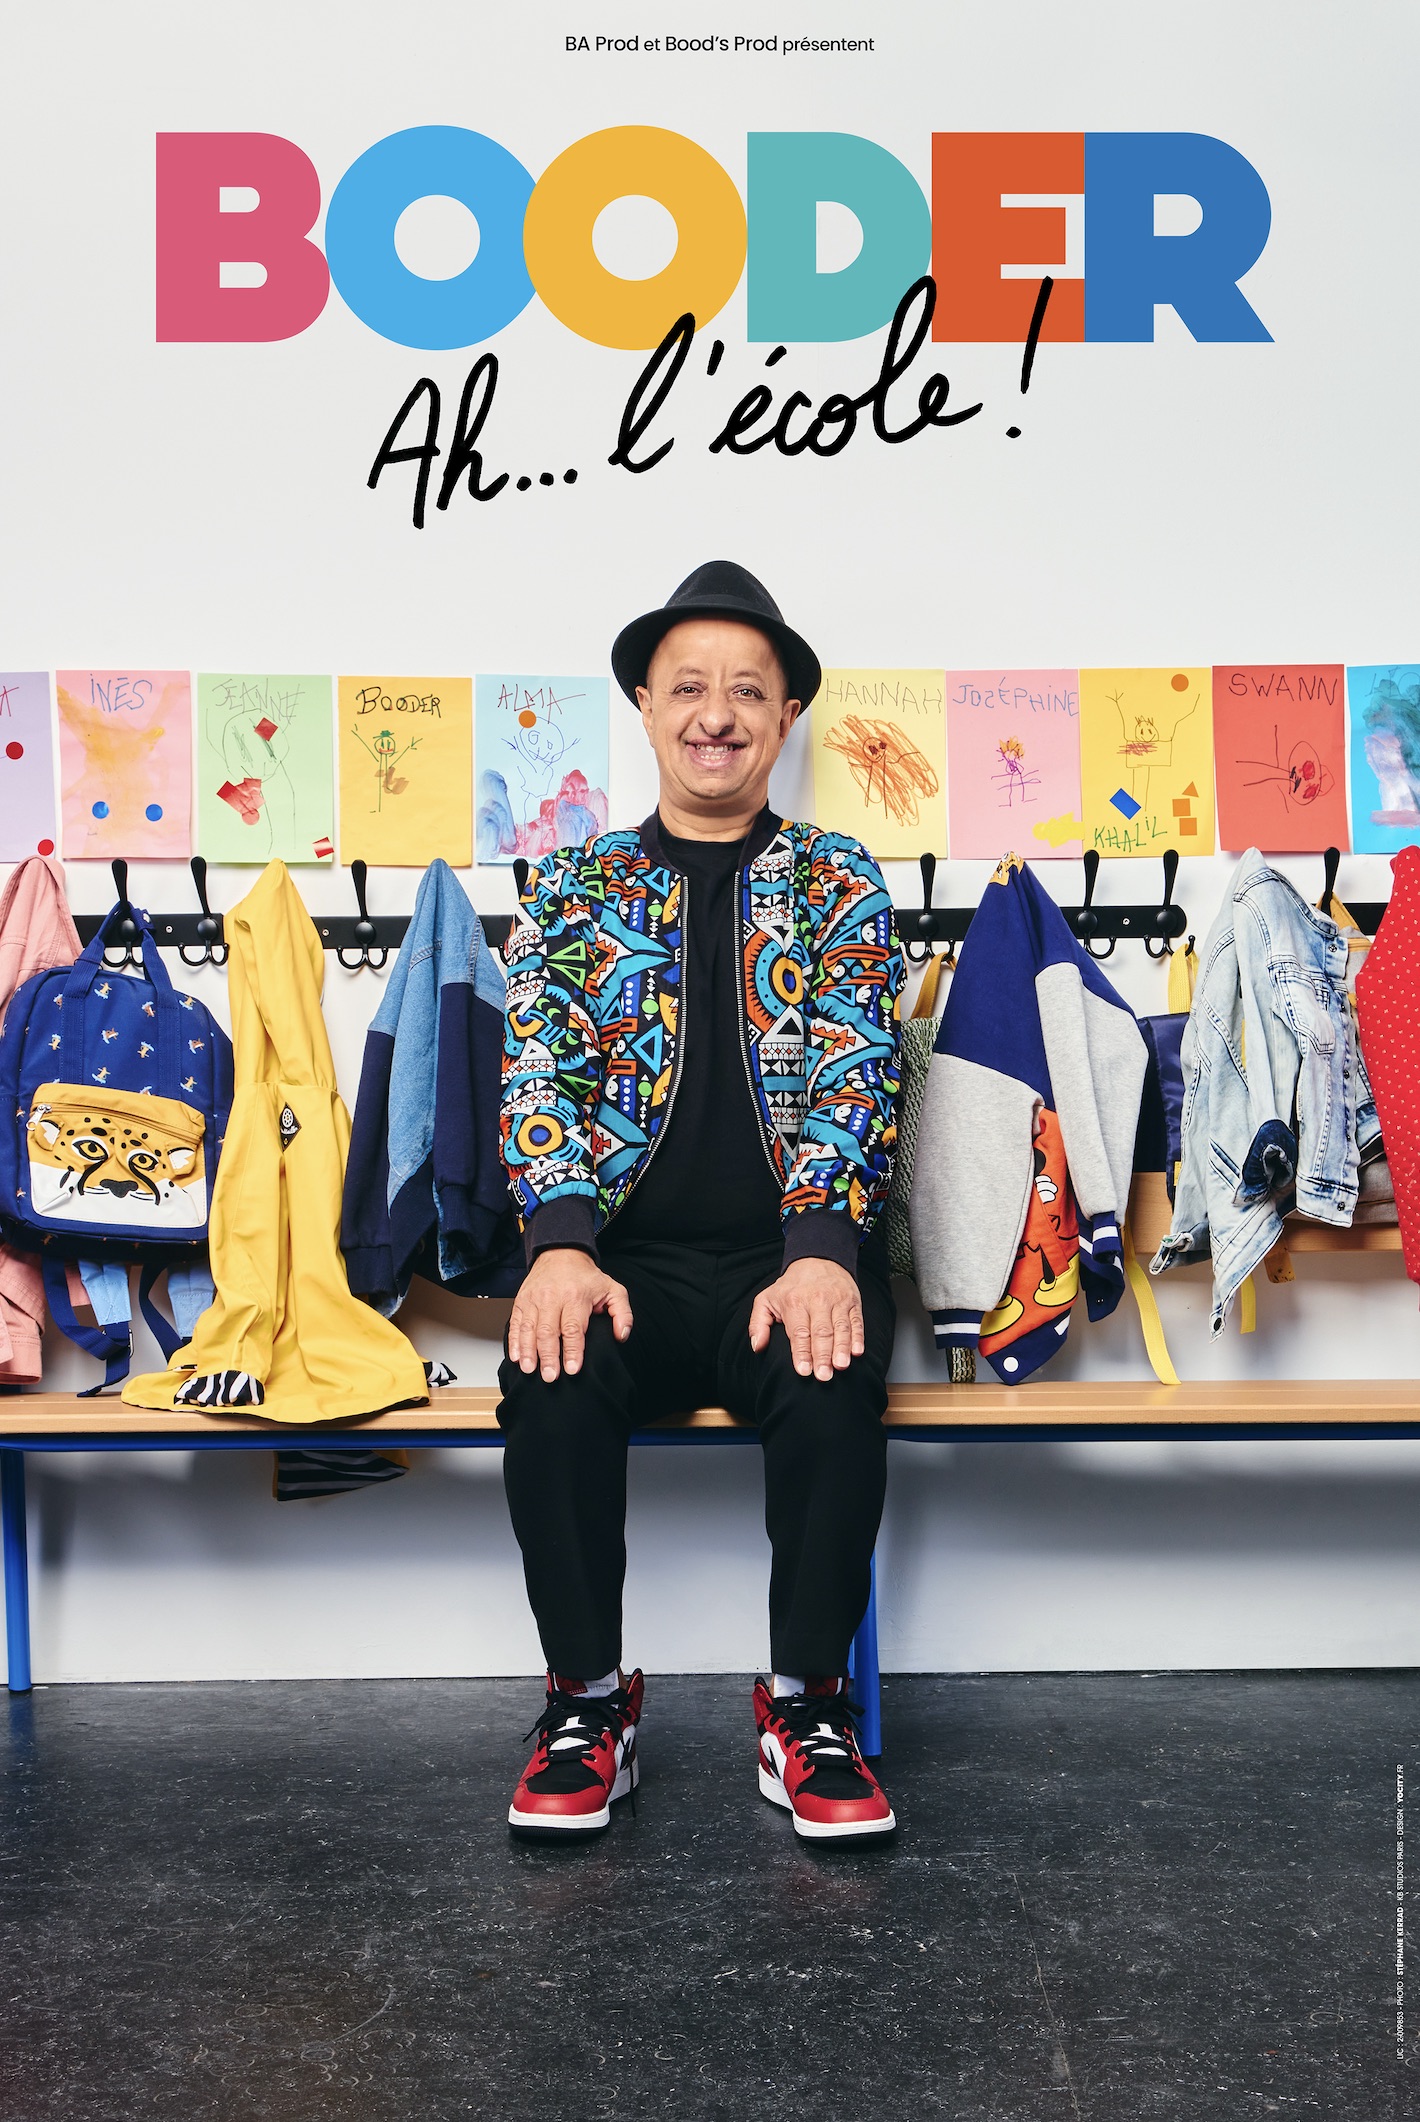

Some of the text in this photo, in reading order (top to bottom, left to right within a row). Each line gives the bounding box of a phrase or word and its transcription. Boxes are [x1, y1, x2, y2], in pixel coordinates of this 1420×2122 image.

[355, 686, 442, 719] BOODER
[497, 683, 587, 725] ALMA
[825, 678, 943, 715] HANNAH
[1228, 673, 1338, 706] SWANN
